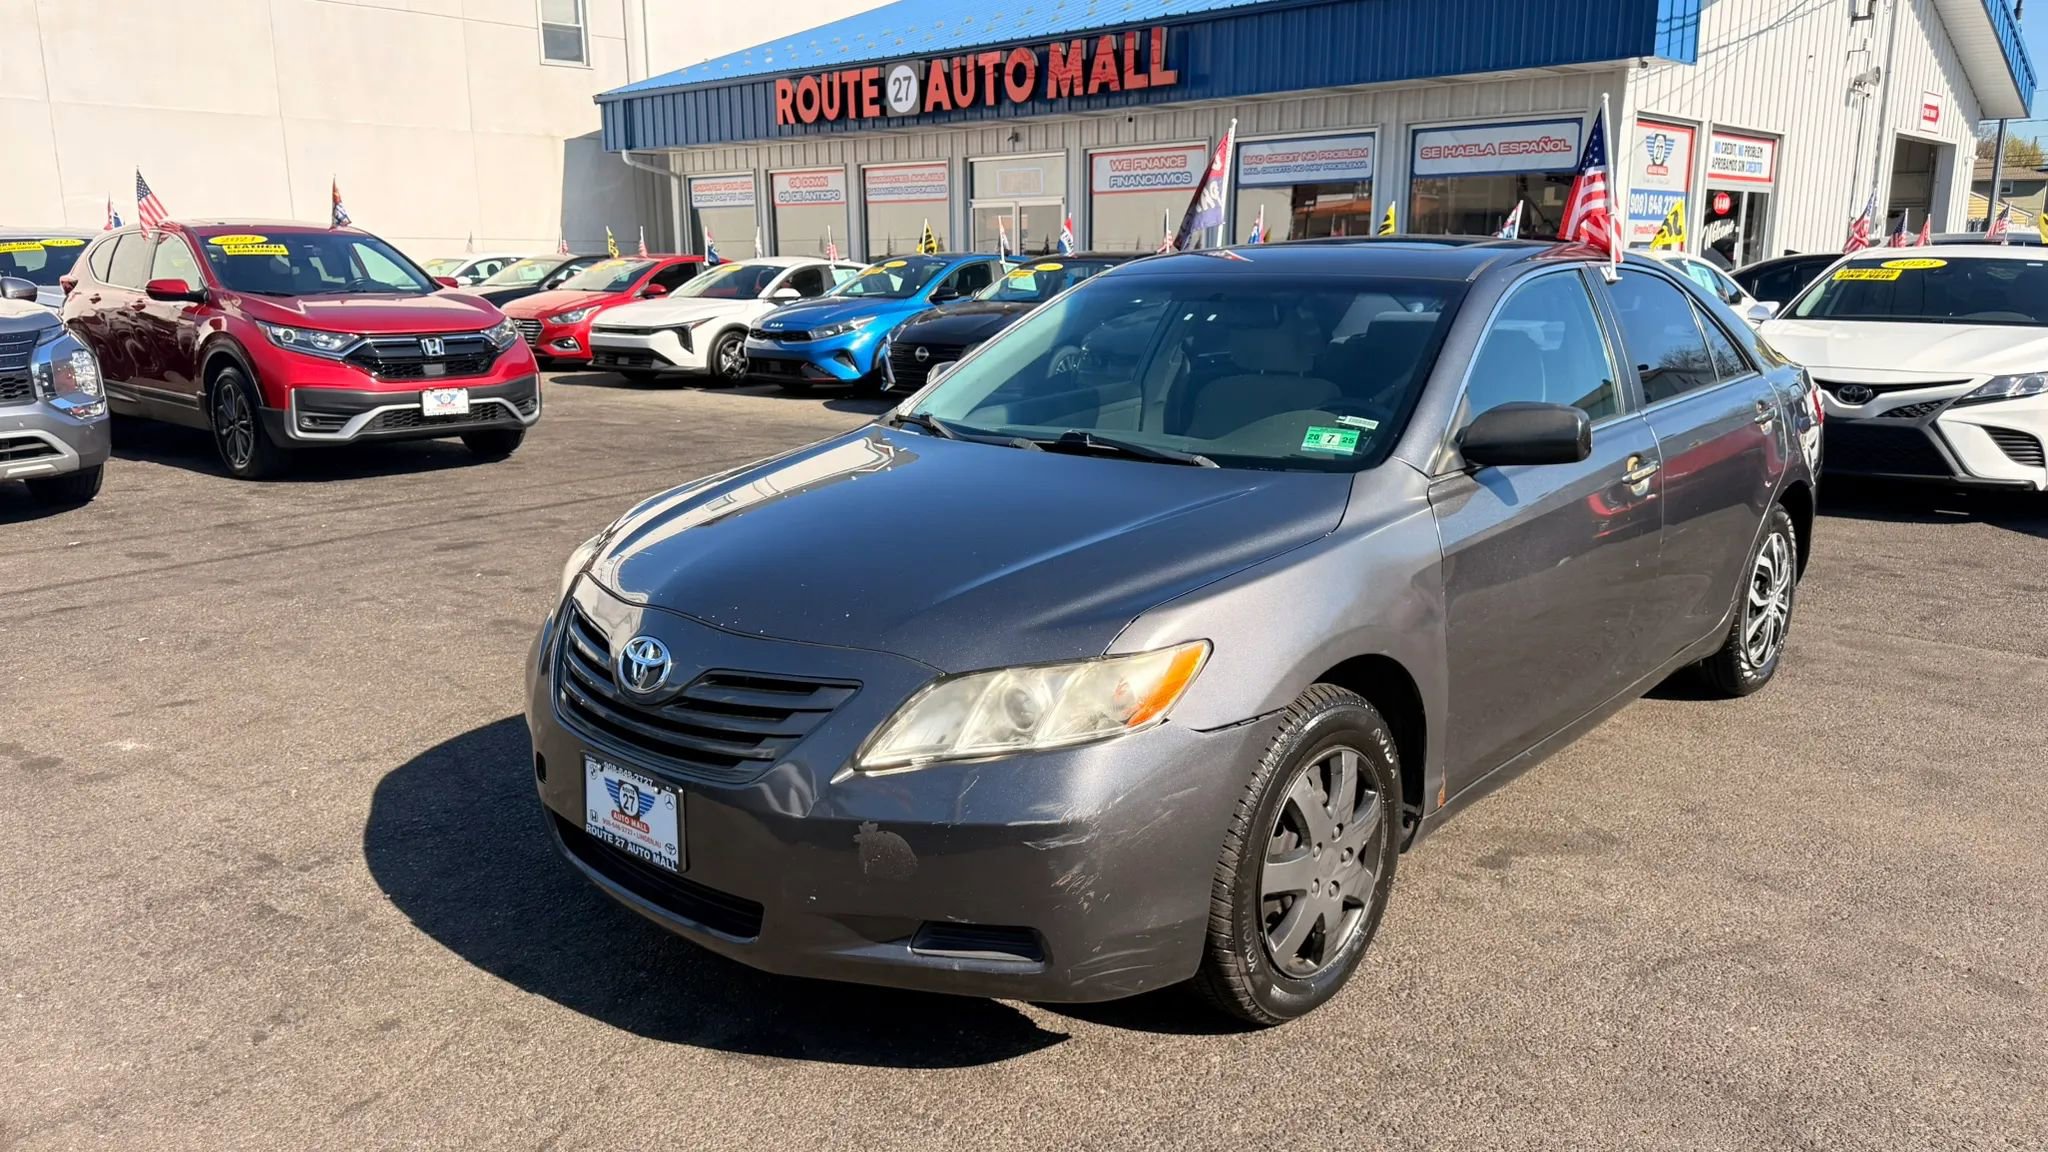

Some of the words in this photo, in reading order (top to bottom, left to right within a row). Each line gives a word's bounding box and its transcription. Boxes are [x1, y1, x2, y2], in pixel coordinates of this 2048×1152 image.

[775, 66, 880, 126] ROUTE
[893, 76, 912, 103] 27
[924, 47, 1036, 113] AUTO
[1046, 26, 1177, 99] MALL
[1421, 146, 1441, 159] SE
[1443, 142, 1496, 158] HABLA
[1498, 136, 1571, 155] ESPAÑOL
[1655, 145, 1664, 160] 27
[1110, 158, 1132, 171] WE
[1132, 155, 1186, 171] FINANCE
[1243, 155, 1265, 165] BAD
[1266, 152, 1299, 164] CREDIT
[1301, 151, 1318, 161] NO
[1320, 148, 1368, 160] PROBLEM
[801, 176, 828, 187] DOWN
[1109, 172, 1192, 188] FINANCIAMOS
[791, 191, 803, 201] DE
[804, 189, 840, 201] ANTICIPO
[1308, 433, 1320, 441] 20
[1327, 434, 1336, 444] 7
[1341, 436, 1354, 444] 25
[623, 793, 635, 812] 27
[613, 812, 630, 824] AUTO
[630, 817, 649, 833] MALL
[586, 823, 614, 844] ROUTE
[615, 837, 625, 849] 27
[627, 841, 651, 860] AUTO
[652, 852, 678, 872] MALL
